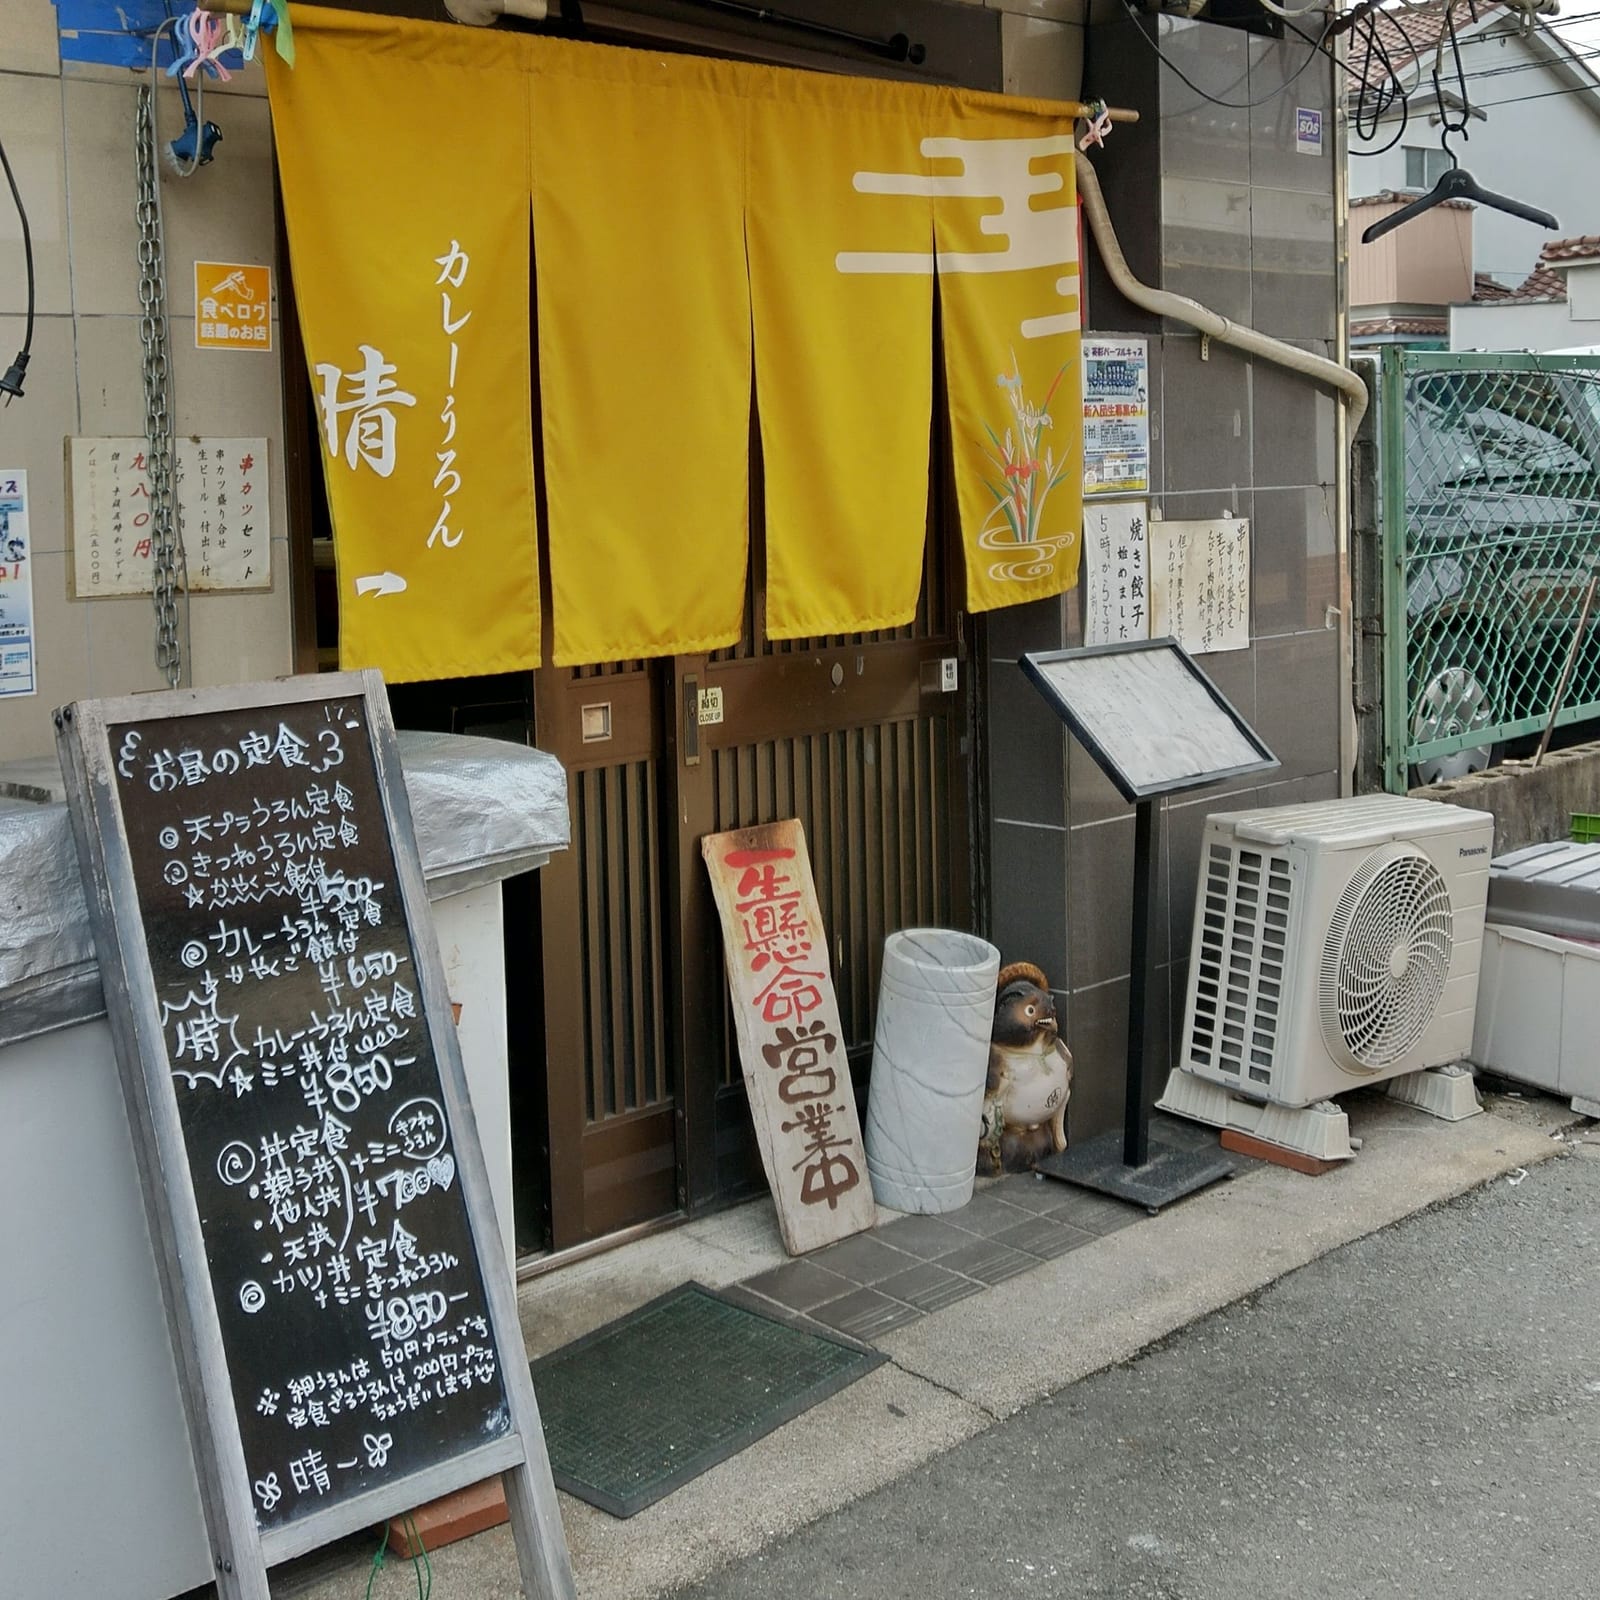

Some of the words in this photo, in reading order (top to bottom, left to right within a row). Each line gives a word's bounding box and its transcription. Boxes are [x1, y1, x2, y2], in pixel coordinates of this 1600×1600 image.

[1300, 120, 1319, 135] SOS
[200, 297, 267, 320] 食べログ
[427, 240, 472, 548] カレーうろん
[216, 449, 228, 549] 串カツ盛り合せ
[239, 453, 254, 580] 串カツセット
[1117, 545, 1129, 640] 始めました
[1130, 517, 1145, 628] 焼き餃子
[145, 722, 311, 792] お昼の定食
[1459, 845, 1488, 858] Panasonic
[724, 848, 860, 1210] 一生懸命営業中
